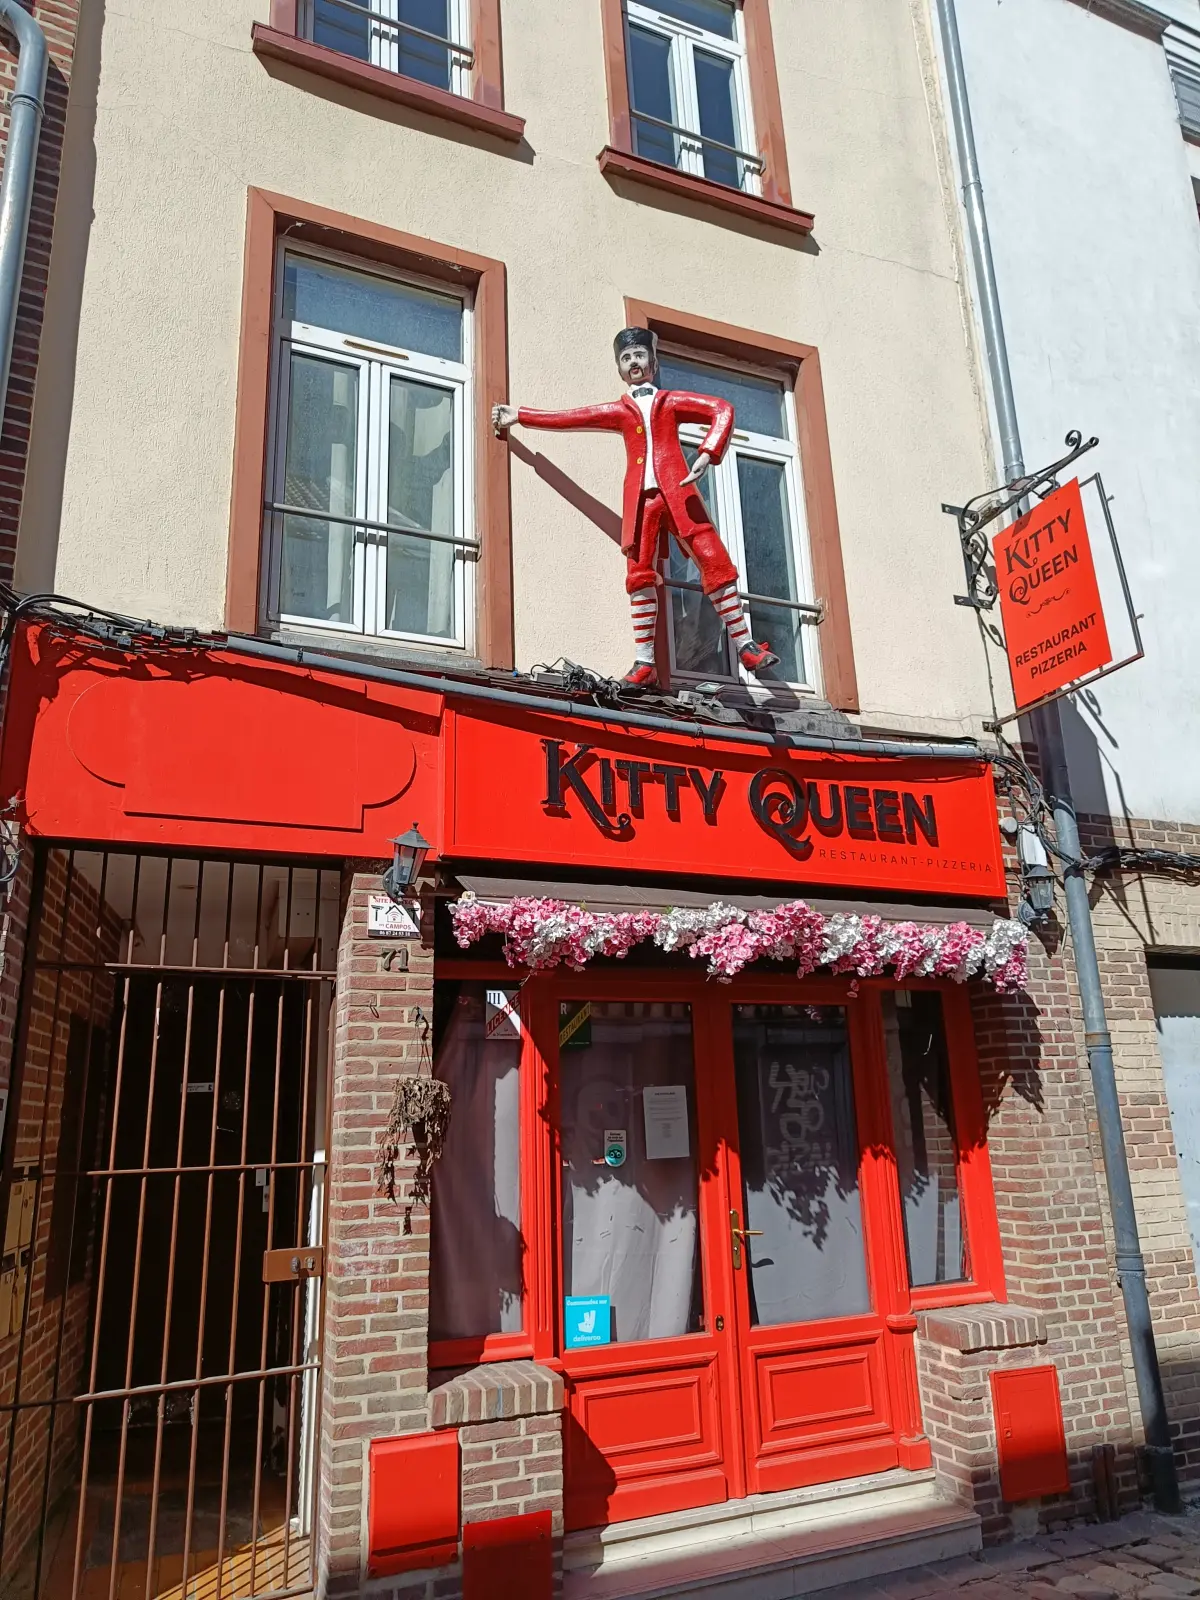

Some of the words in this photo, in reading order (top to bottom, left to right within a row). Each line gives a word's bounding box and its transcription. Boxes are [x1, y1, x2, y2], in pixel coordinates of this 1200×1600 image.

[1004, 508, 1072, 575] KITTY
[1009, 545, 1079, 605] QUEEN
[1015, 612, 1097, 668] RESTAURANT
[1030, 641, 1087, 679] PIZZERIA
[541, 739, 723, 831] KITTY
[748, 767, 935, 850] QUEEN
[818, 849, 993, 873] RESTAURANT-PIZZERIA
[381, 947, 409, 971] 71
[487, 993, 520, 1034] LICENCE
[488, 993, 500, 1004] III
[561, 1003, 567, 1014] R
